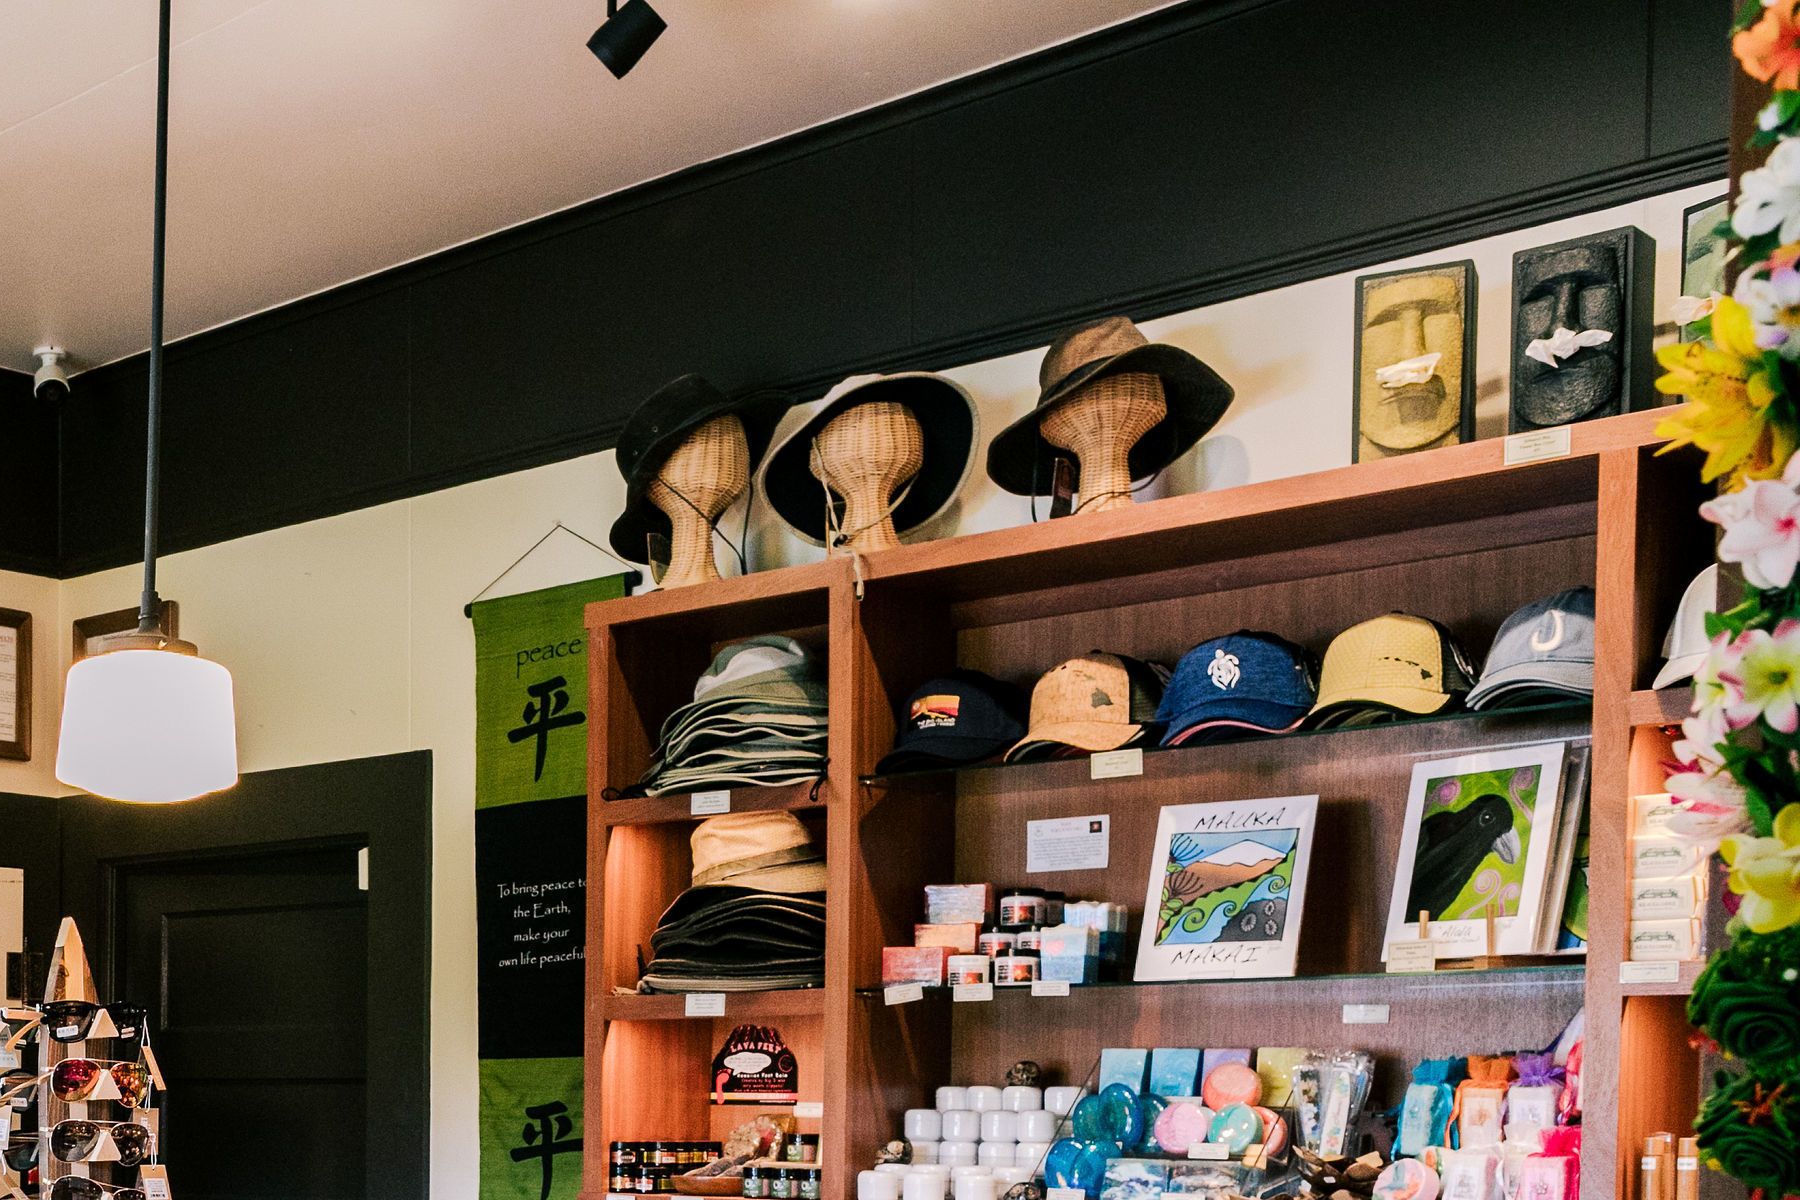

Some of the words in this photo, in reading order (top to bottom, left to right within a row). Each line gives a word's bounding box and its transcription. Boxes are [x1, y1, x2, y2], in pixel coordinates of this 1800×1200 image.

[517, 638, 583, 679] peace
[507, 675, 586, 783] 平
[1195, 806, 1286, 831] MAUKA
[497, 883, 511, 898] To
[512, 881, 540, 898] bring
[540, 880, 575, 897] peace
[513, 905, 531, 919] the
[533, 901, 571, 919] Earth,
[513, 928, 541, 943] make
[542, 928, 571, 944] your
[498, 958, 518, 968] own
[520, 950, 537, 965] life
[1170, 945, 1262, 965] MAKAI
[730, 1042, 756, 1053] LAVA
